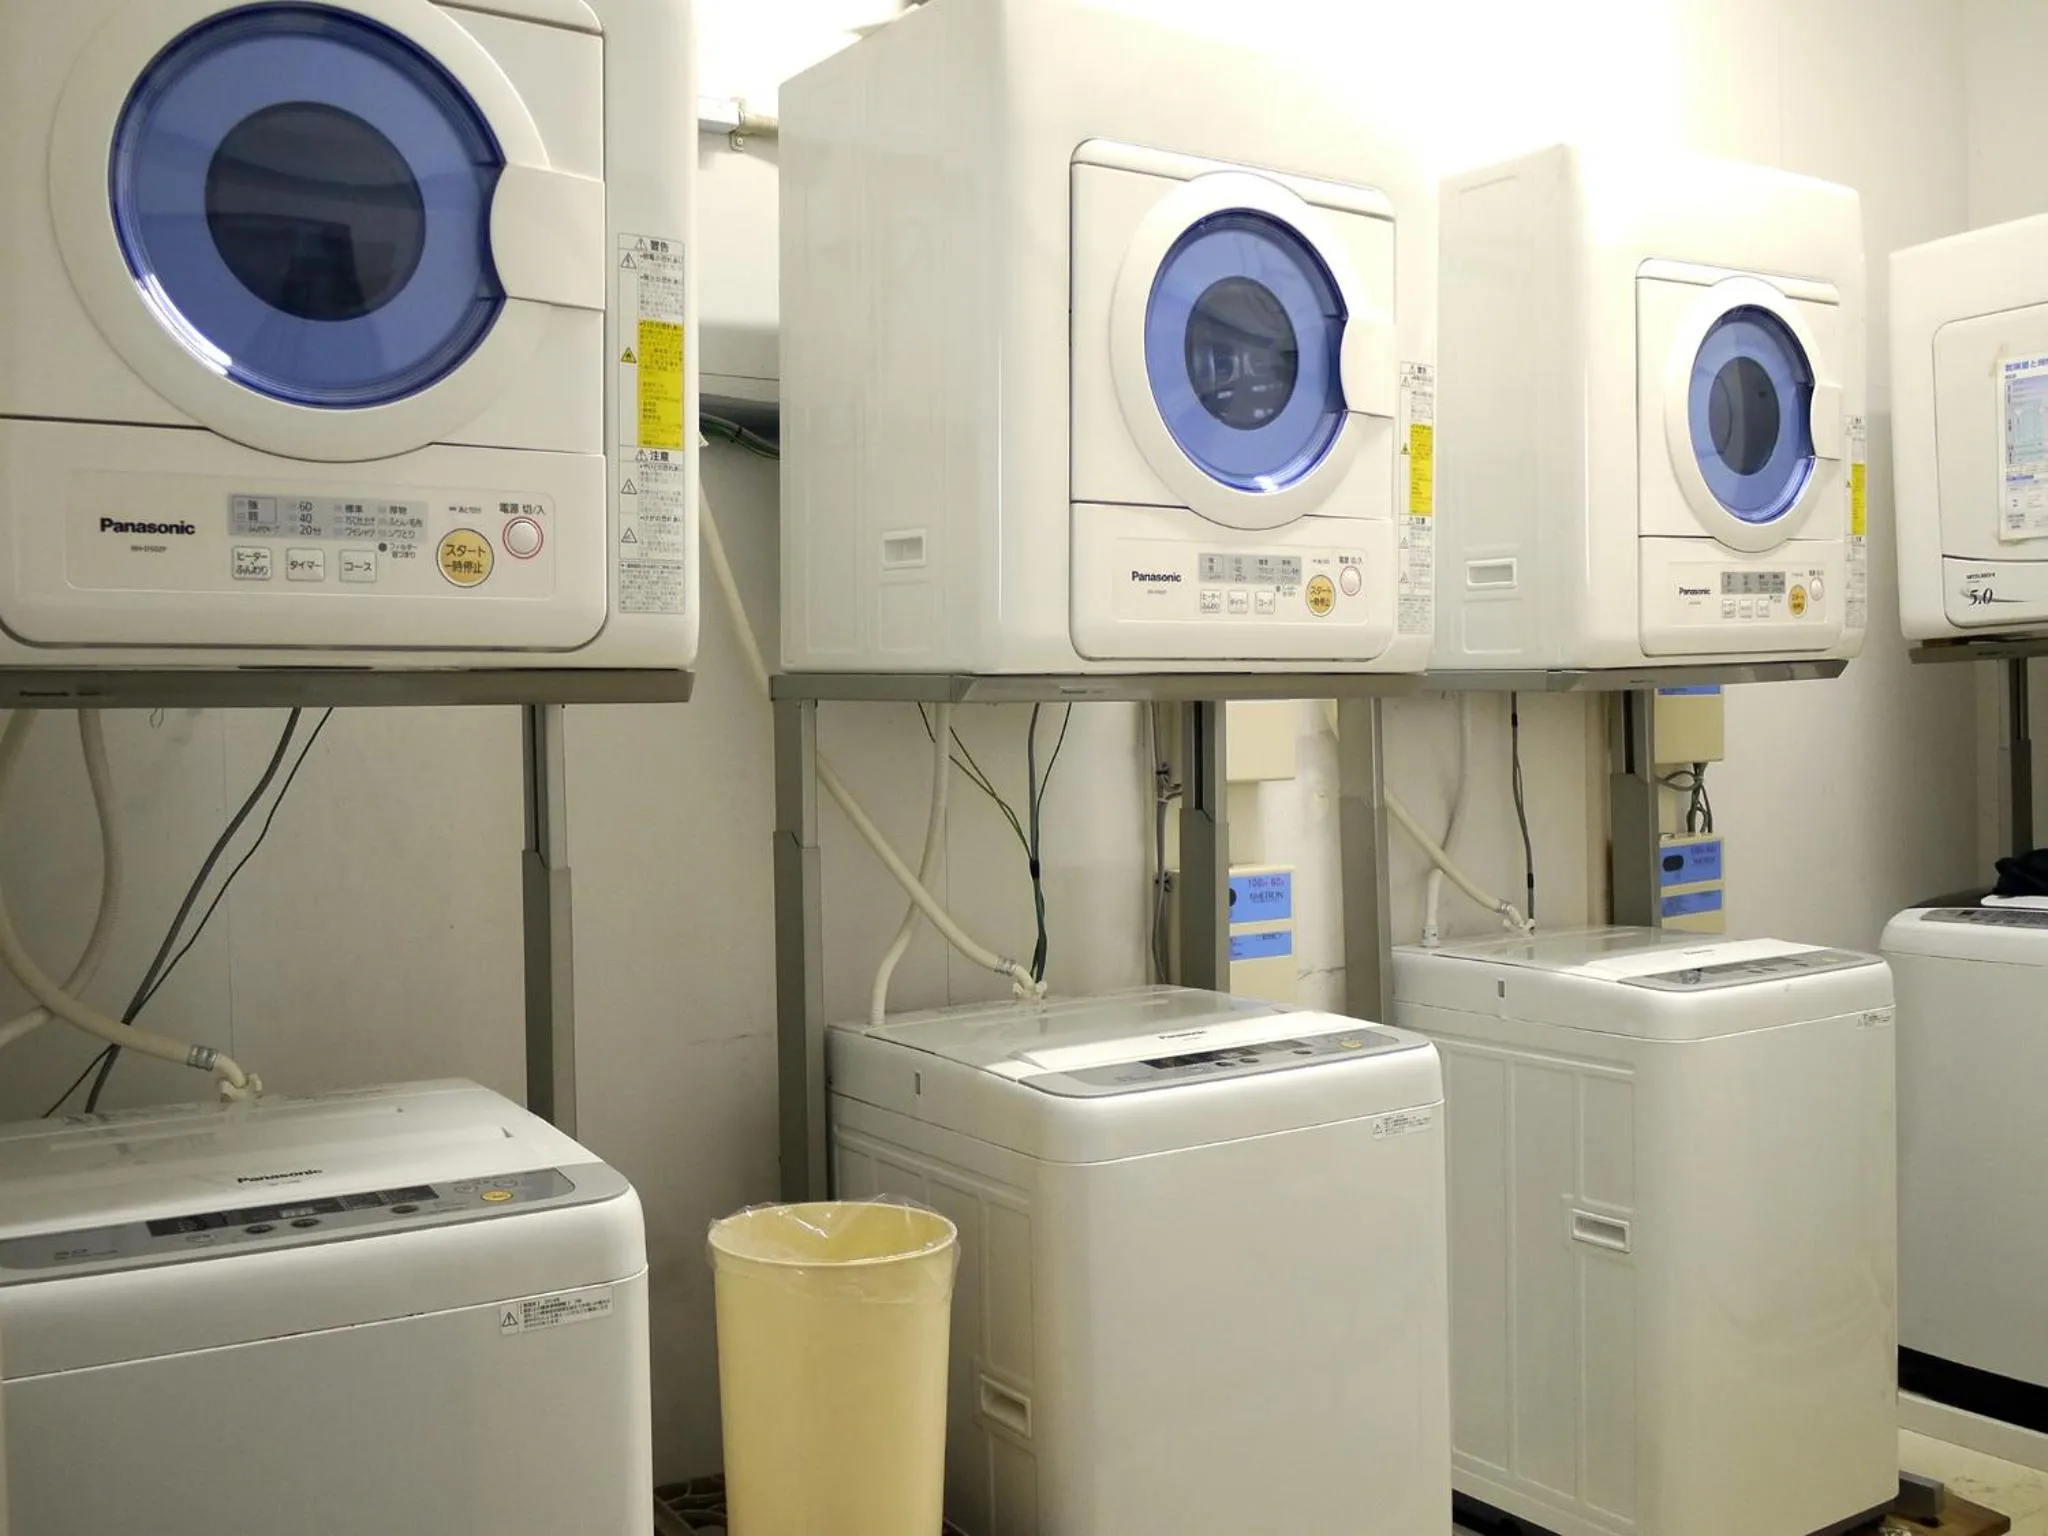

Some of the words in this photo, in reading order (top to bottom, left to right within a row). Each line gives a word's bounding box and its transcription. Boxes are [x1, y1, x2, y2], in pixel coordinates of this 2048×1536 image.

[650, 239, 669, 252] 警告
[650, 450, 669, 461] 注意
[299, 500, 312, 512] 60
[499, 503, 519, 514] 電源
[299, 512, 312, 524] 40
[100, 517, 196, 536] Panasonic
[236, 551, 268, 562] ヒーター
[445, 543, 487, 559] スタート
[290, 560, 323, 571] タイマー
[343, 561, 373, 572] コース
[444, 560, 484, 575] 一時停止
[1131, 570, 1182, 582] Panasonic
[1969, 587, 1993, 606] 5.0
[237, 1169, 323, 1184] Panasonic
